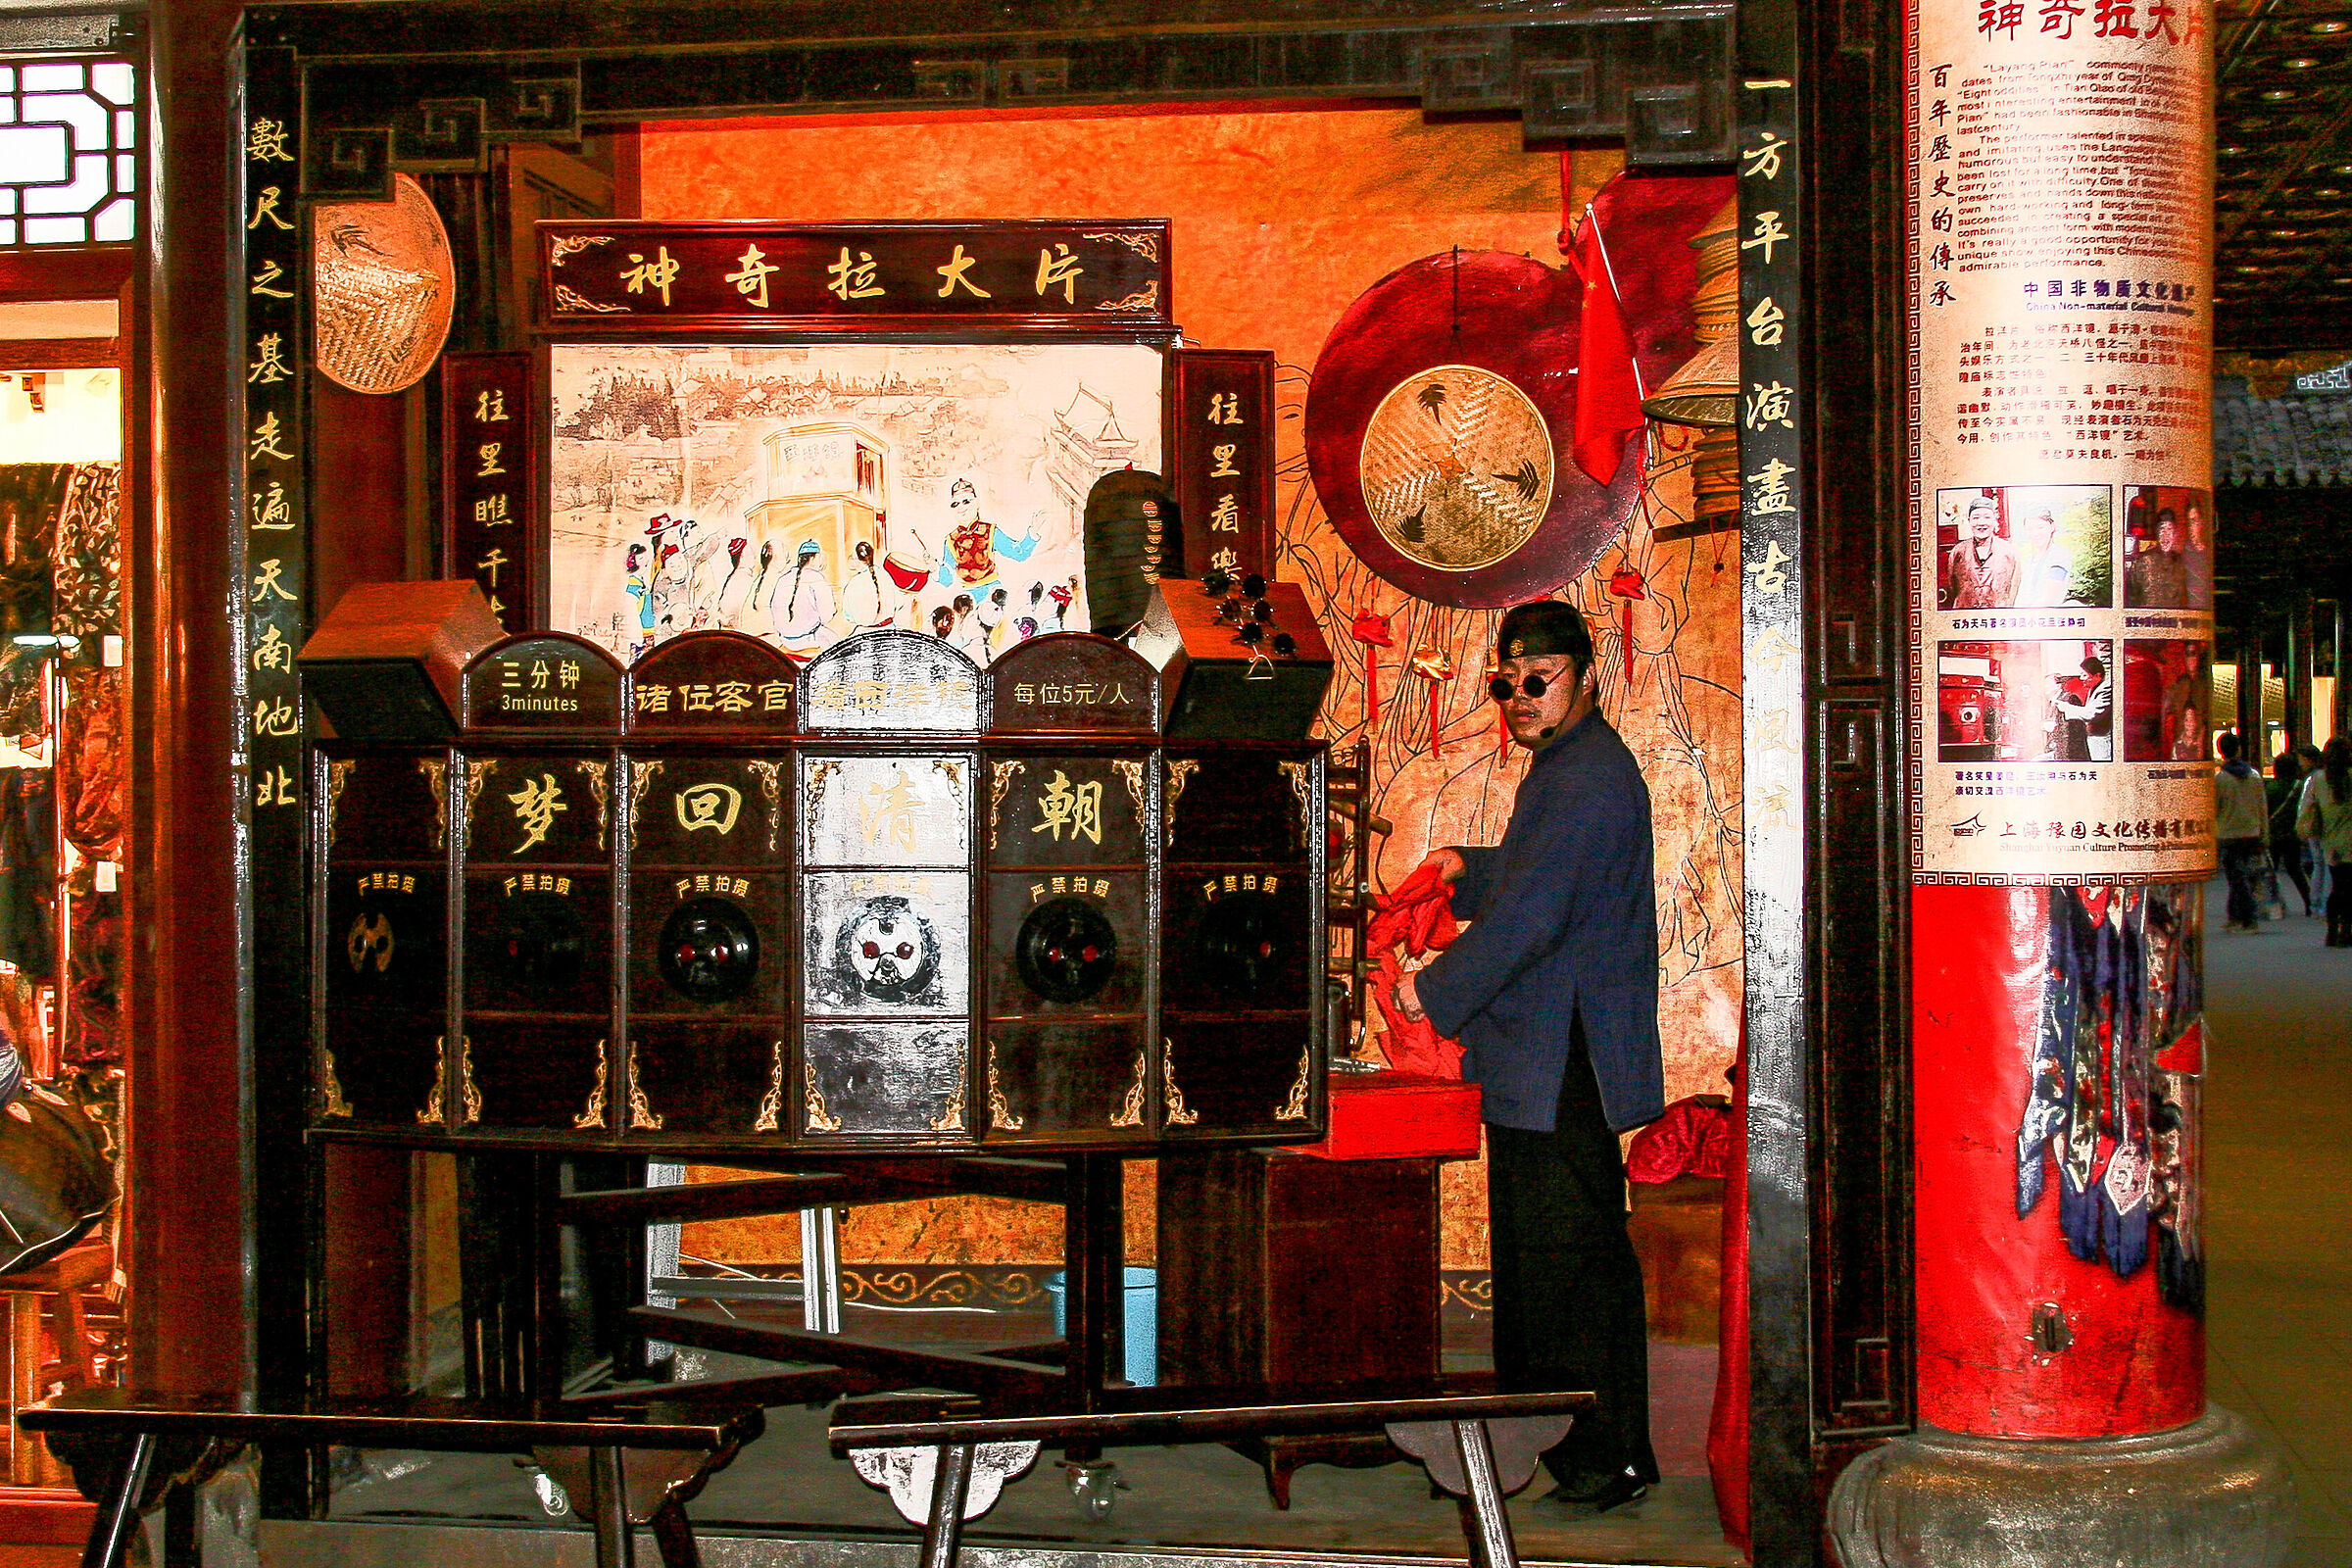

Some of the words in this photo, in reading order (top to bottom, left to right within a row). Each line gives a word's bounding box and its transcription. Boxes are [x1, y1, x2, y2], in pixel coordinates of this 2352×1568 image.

[1961, 77, 1992, 88] dates
[1998, 74, 2023, 83] from
[1994, 110, 2016, 120] had
[2020, 109, 2049, 118] been
[1980, 135, 2001, 144] The
[2004, 132, 2063, 143] performer
[2066, 131, 2113, 141] talented
[1958, 148, 1981, 158] and
[2080, 143, 2099, 152] the
[1958, 158, 2019, 170] humorous
[2045, 154, 2074, 164] easy
[2077, 154, 2088, 163] to
[1957, 171, 1984, 181] been
[1989, 169, 2010, 178] lost
[1957, 182, 1986, 193] carry
[1989, 181, 2004, 190] on
[2019, 177, 2042, 186] with
[1957, 191, 2015, 205] preserves
[1958, 206, 1982, 216] own
[1989, 201, 2069, 213] hard-working
[2072, 200, 2093, 209] and
[1958, 215, 2020, 226] succeeded
[1957, 226, 2014, 238] combining
[1982, 237, 2016, 248] really
[1957, 251, 1998, 262] unique
[2093, 246, 2115, 255] this
[1959, 260, 2019, 272] admirable
[619, 242, 1084, 308] 神奇拉大片
[475, 390, 514, 624] 往里瞧千
[501, 660, 580, 691] 三分钟
[502, 694, 579, 713] 3minutes
[635, 680, 794, 713] 诸位客官
[508, 773, 567, 854] 梦
[675, 782, 743, 835] 回
[1031, 770, 1103, 845] 朝
[2082, 842, 2117, 853] Culture
[504, 873, 571, 897] 严禁拍摄
[676, 874, 752, 899] 严禁拍摄
[1030, 875, 1110, 903] 严禁拍摄
[1203, 874, 1278, 901] 严禁拍摄
